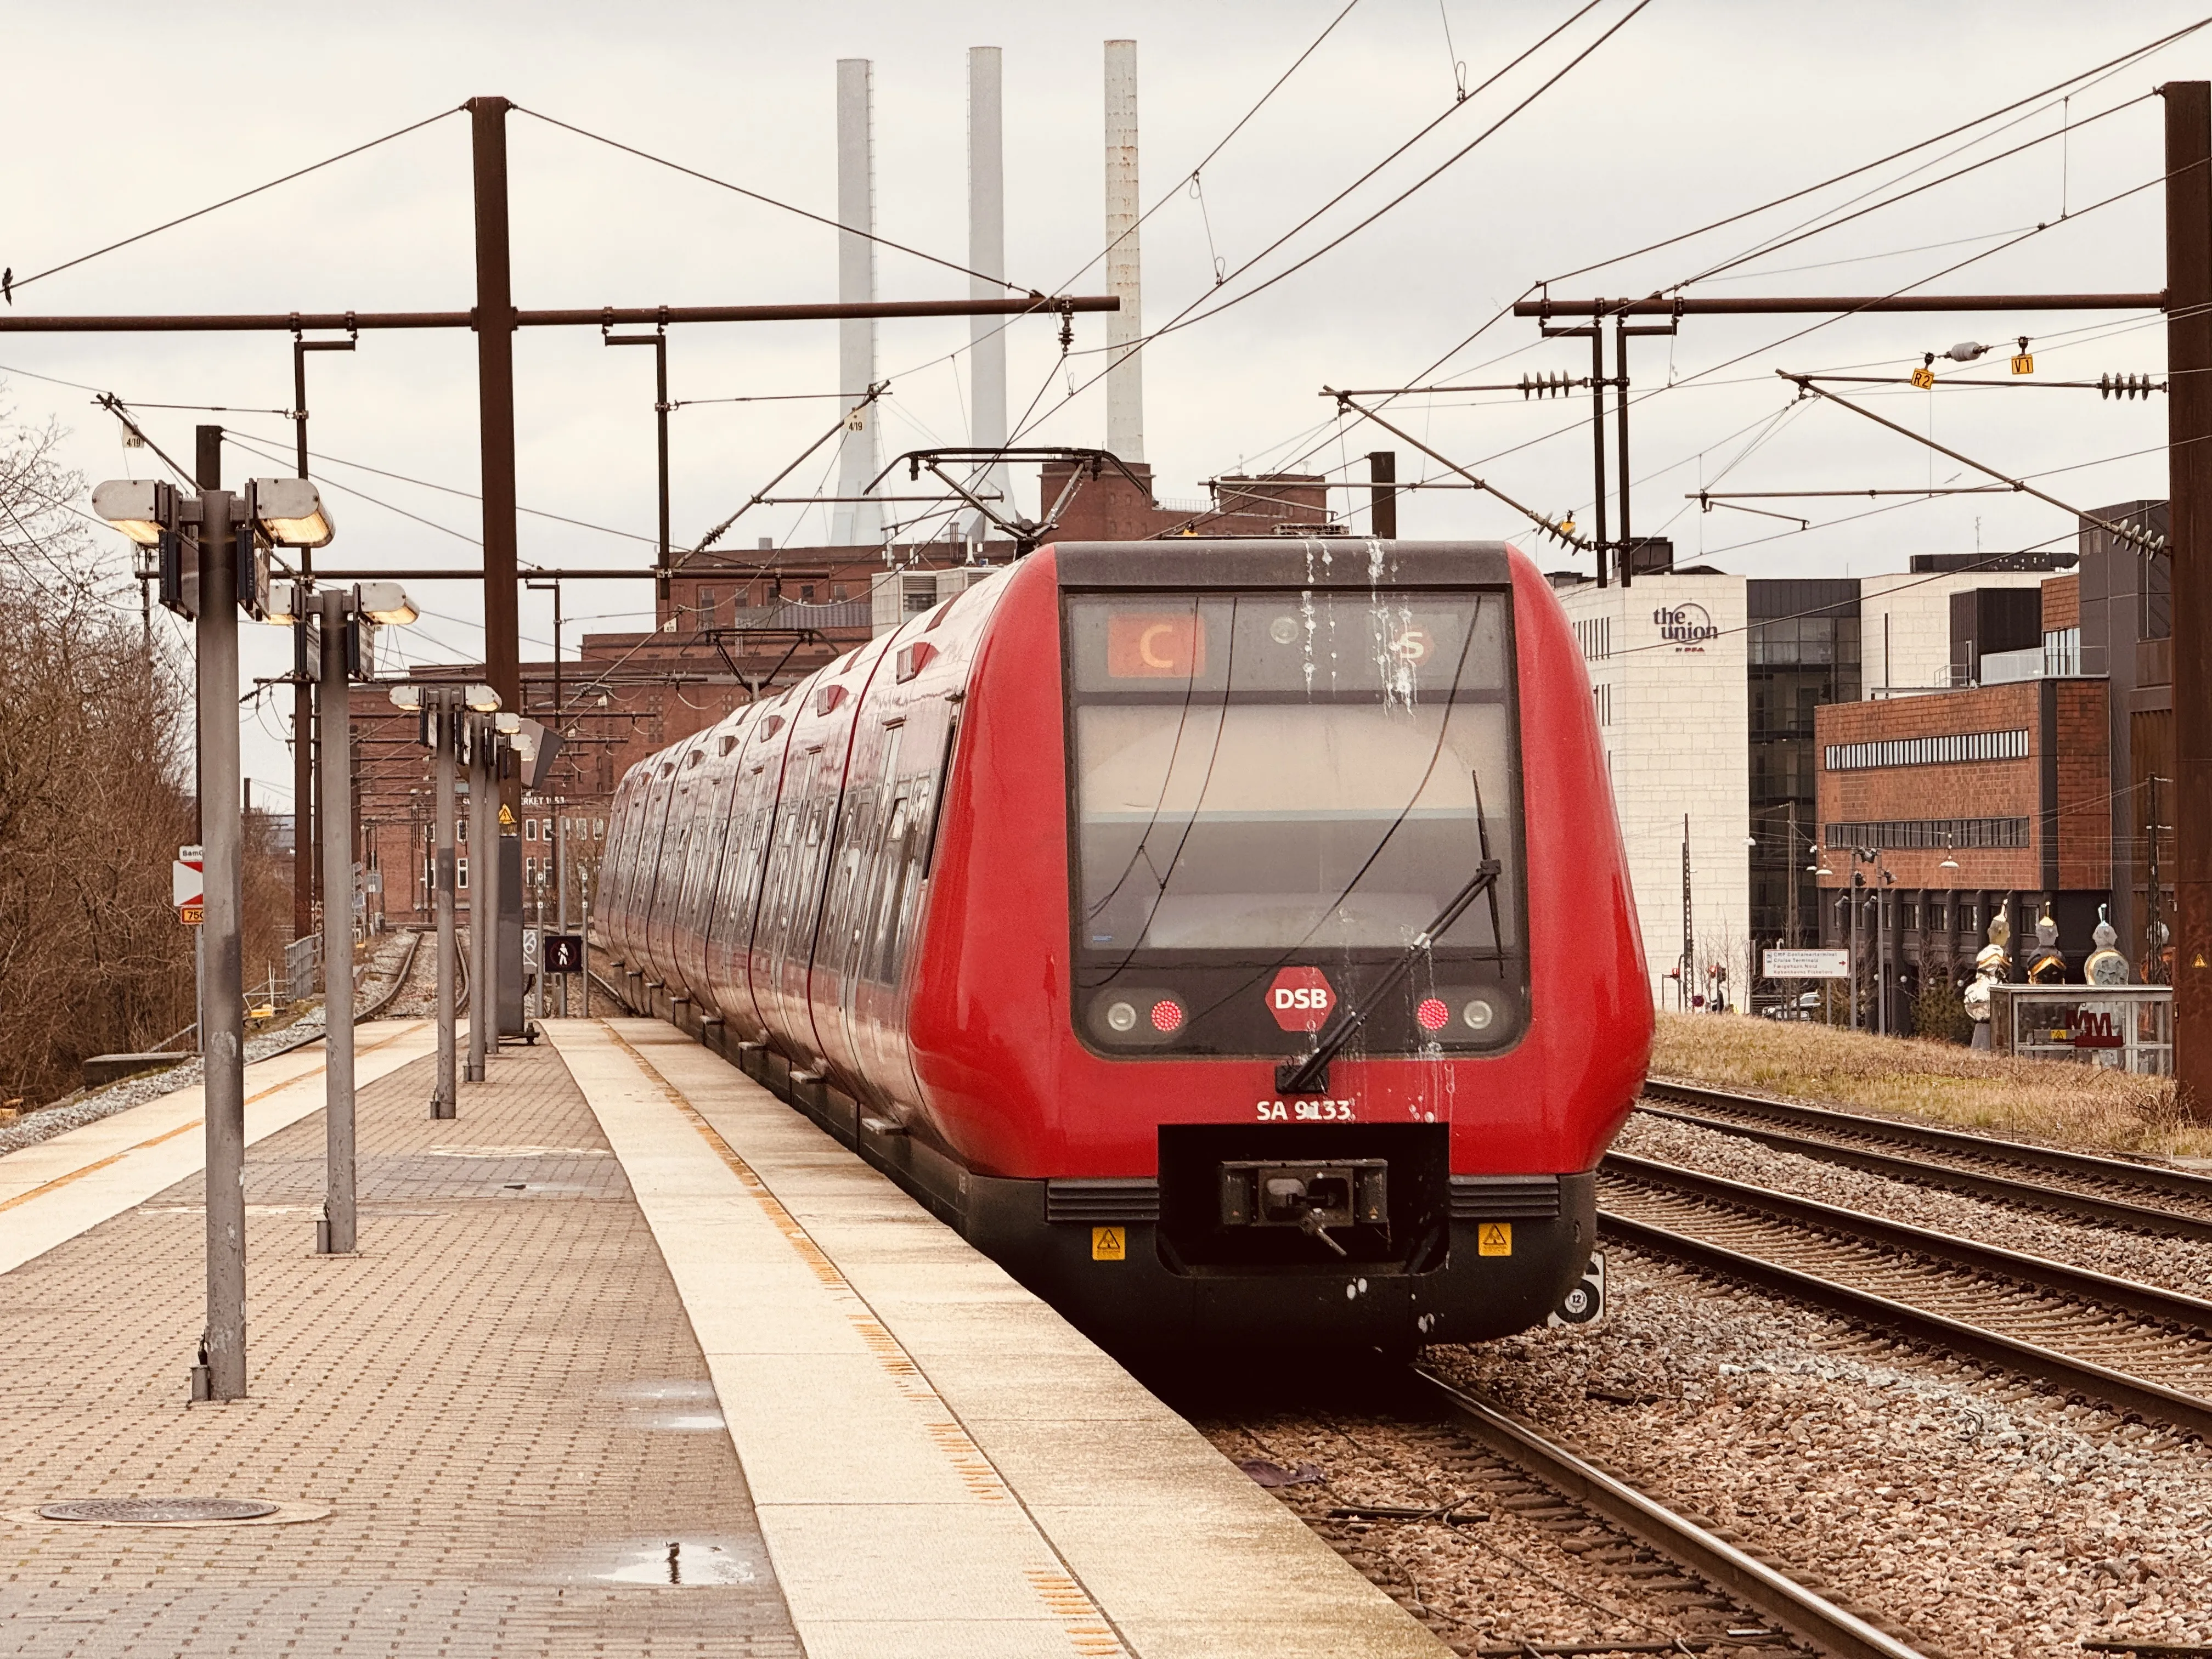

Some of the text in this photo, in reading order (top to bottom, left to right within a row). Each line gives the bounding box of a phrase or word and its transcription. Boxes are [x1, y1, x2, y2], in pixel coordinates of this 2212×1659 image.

[2015, 359, 2030, 373] V1
[1913, 373, 1931, 387] R2
[849, 421, 862, 431] 4/19
[127, 438, 140, 447] 4/19
[1653, 607, 1686, 624] the
[1661, 622, 1718, 639] union
[1139, 624, 1173, 668] C
[1275, 988, 1328, 1009] DSB
[1256, 1100, 1352, 1121] SA 9133
